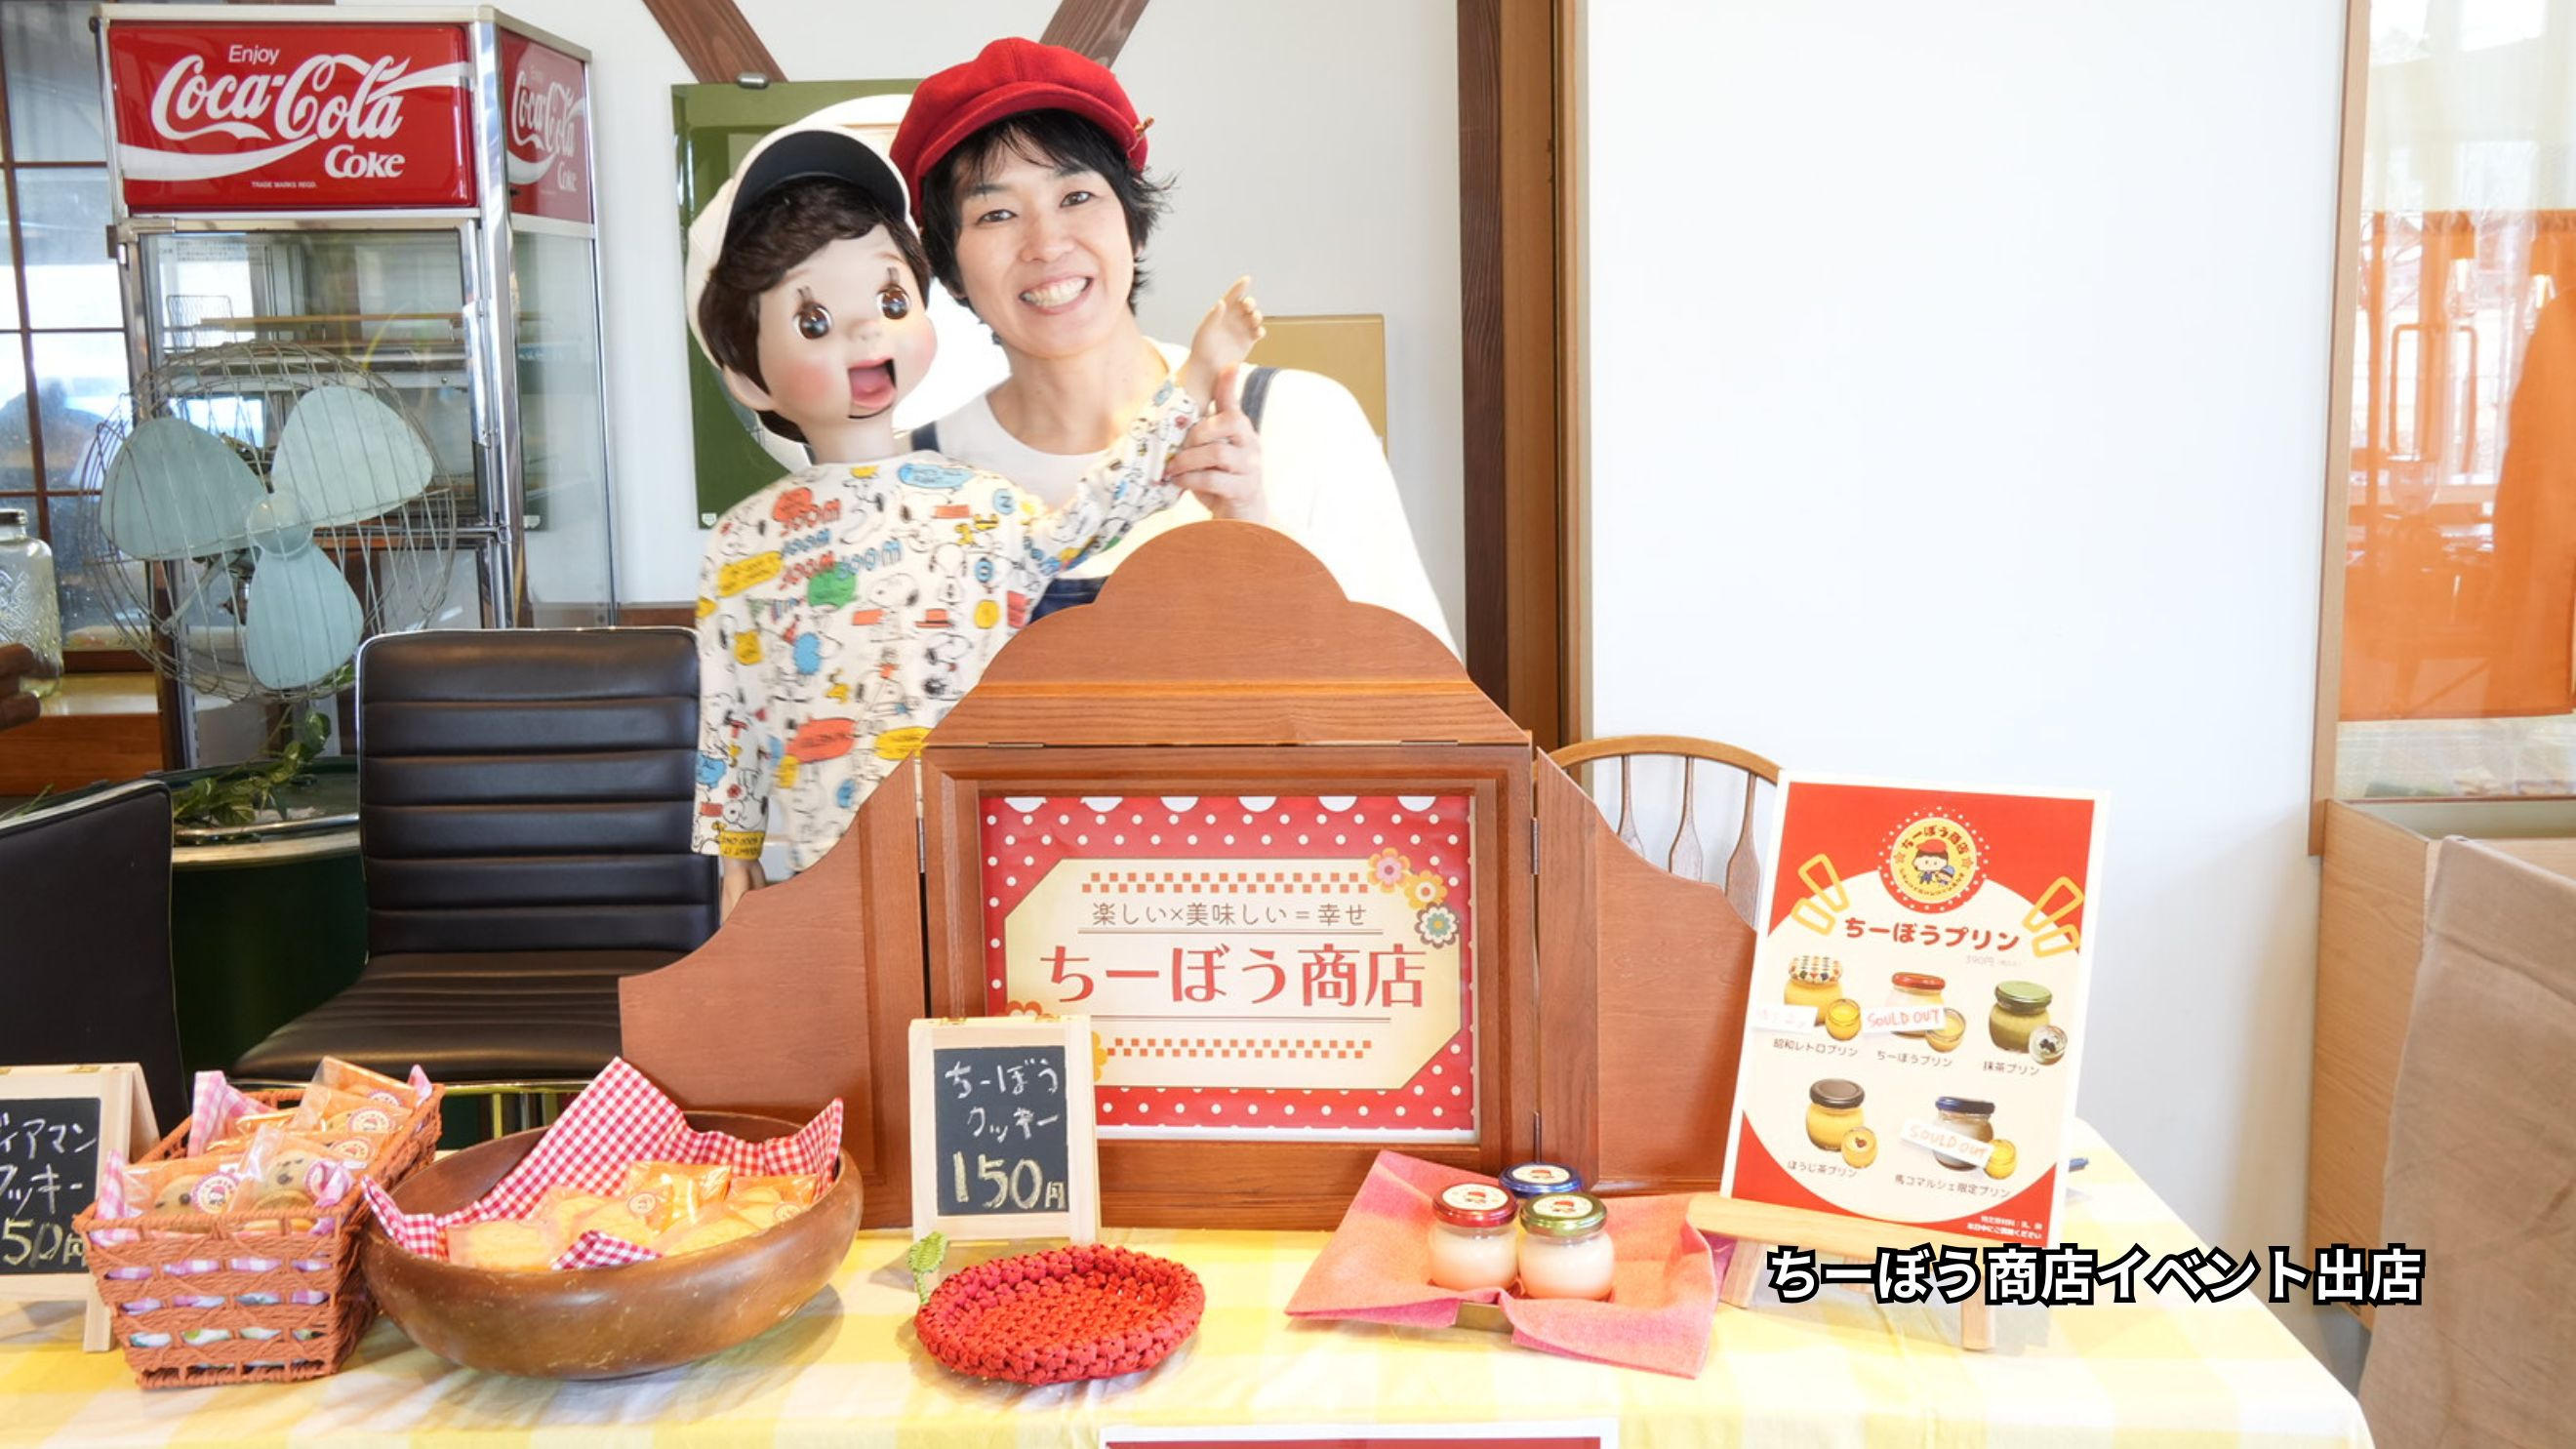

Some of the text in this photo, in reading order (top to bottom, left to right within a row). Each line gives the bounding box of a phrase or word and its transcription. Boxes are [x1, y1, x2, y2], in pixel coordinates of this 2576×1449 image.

[228, 45, 280, 64] Enjoy
[151, 54, 410, 141] Coca-Cola
[324, 144, 406, 179] Coke
[1845, 917, 2020, 951] ちーぼうプリン
[1040, 943, 1428, 1008] ちーぼう商店
[1912, 1008, 1940, 1025] OUT
[1773, 1037, 1859, 1057] 昭和レトロプリン
[1876, 1049, 1952, 1067] ちーぼうプリン
[944, 1057, 1060, 1099] ちーぼう
[1983, 1061, 2039, 1076] 抹茶プリン
[967, 1106, 1060, 1144] クッキー
[1788, 1160, 1858, 1178] ほうじ茶プリン
